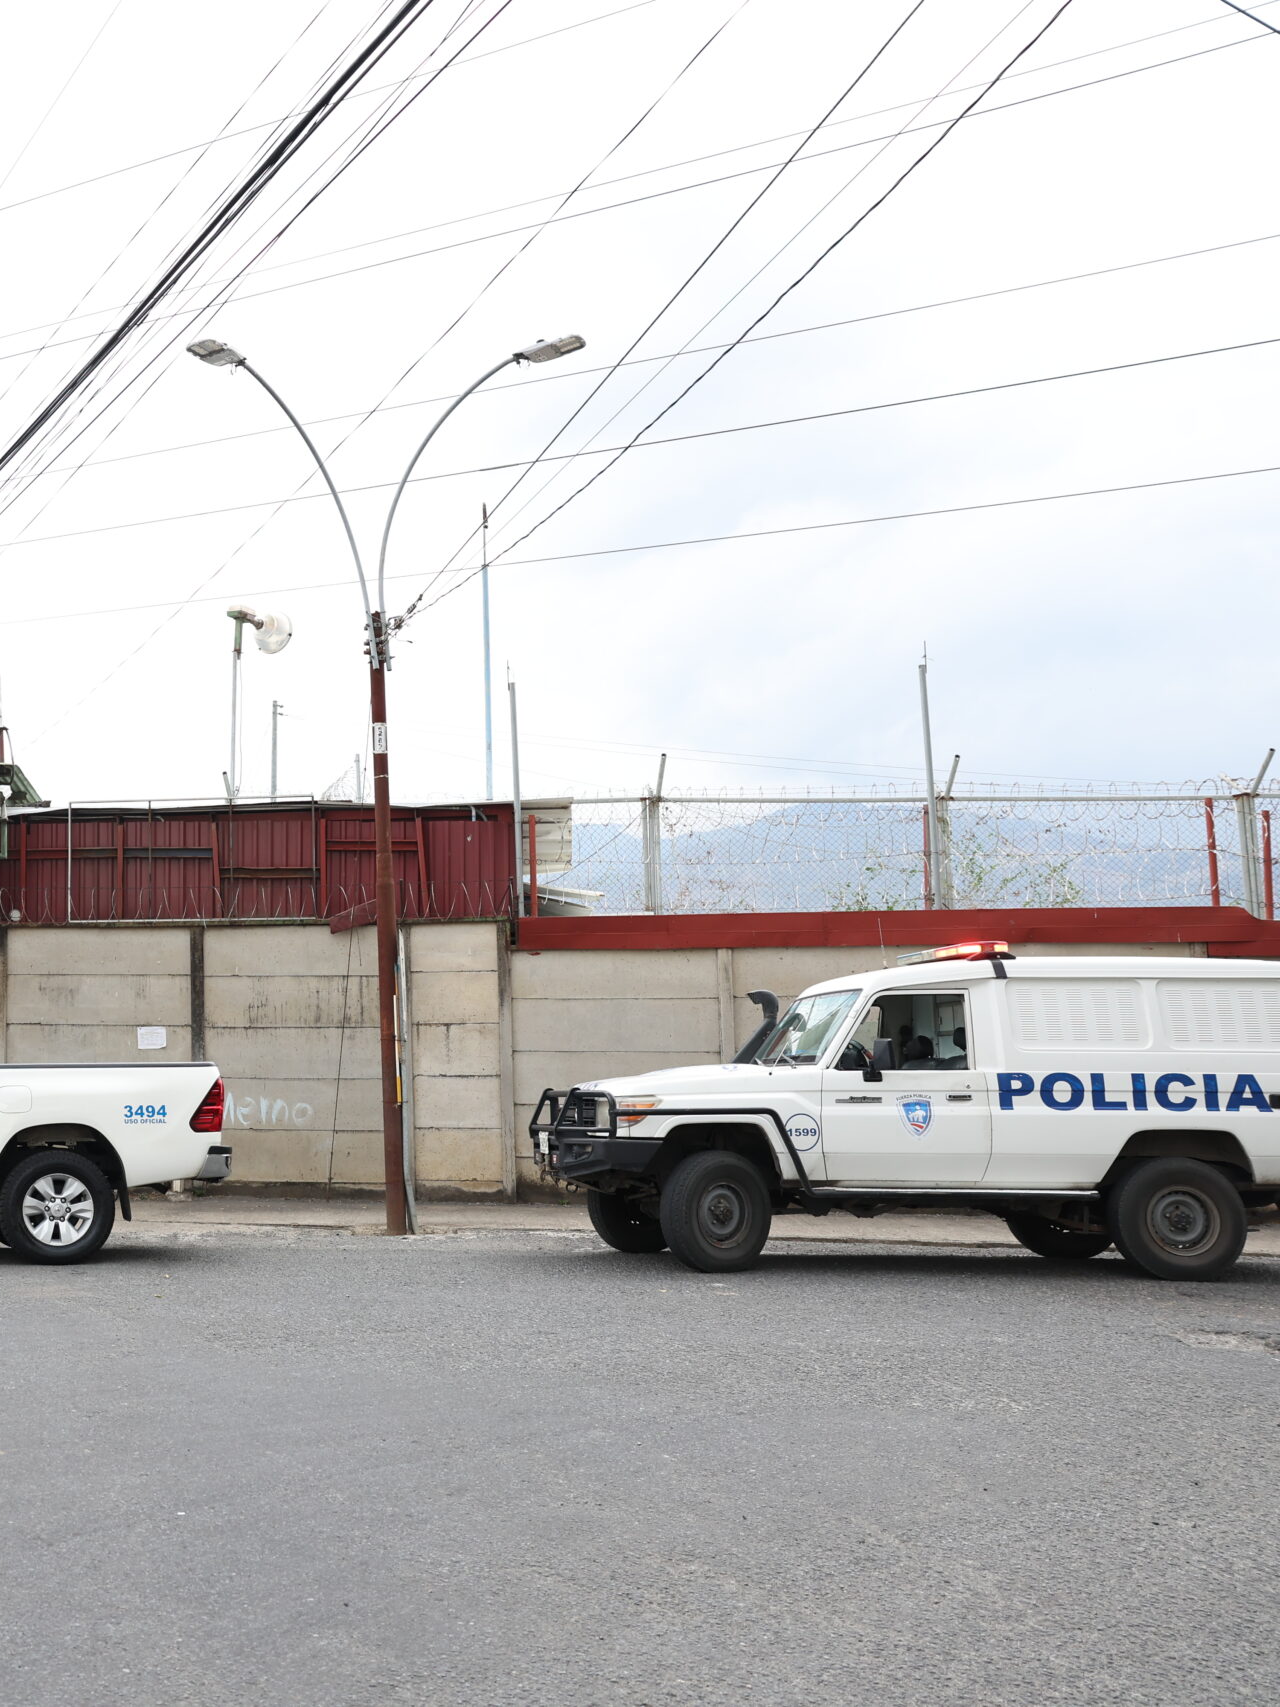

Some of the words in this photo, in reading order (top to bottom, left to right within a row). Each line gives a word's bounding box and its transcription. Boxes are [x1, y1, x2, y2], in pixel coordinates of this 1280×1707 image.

[996, 1072, 1273, 1112] POLICIA
[123, 1104, 168, 1118] 3494
[787, 1127, 818, 1137] 1599
